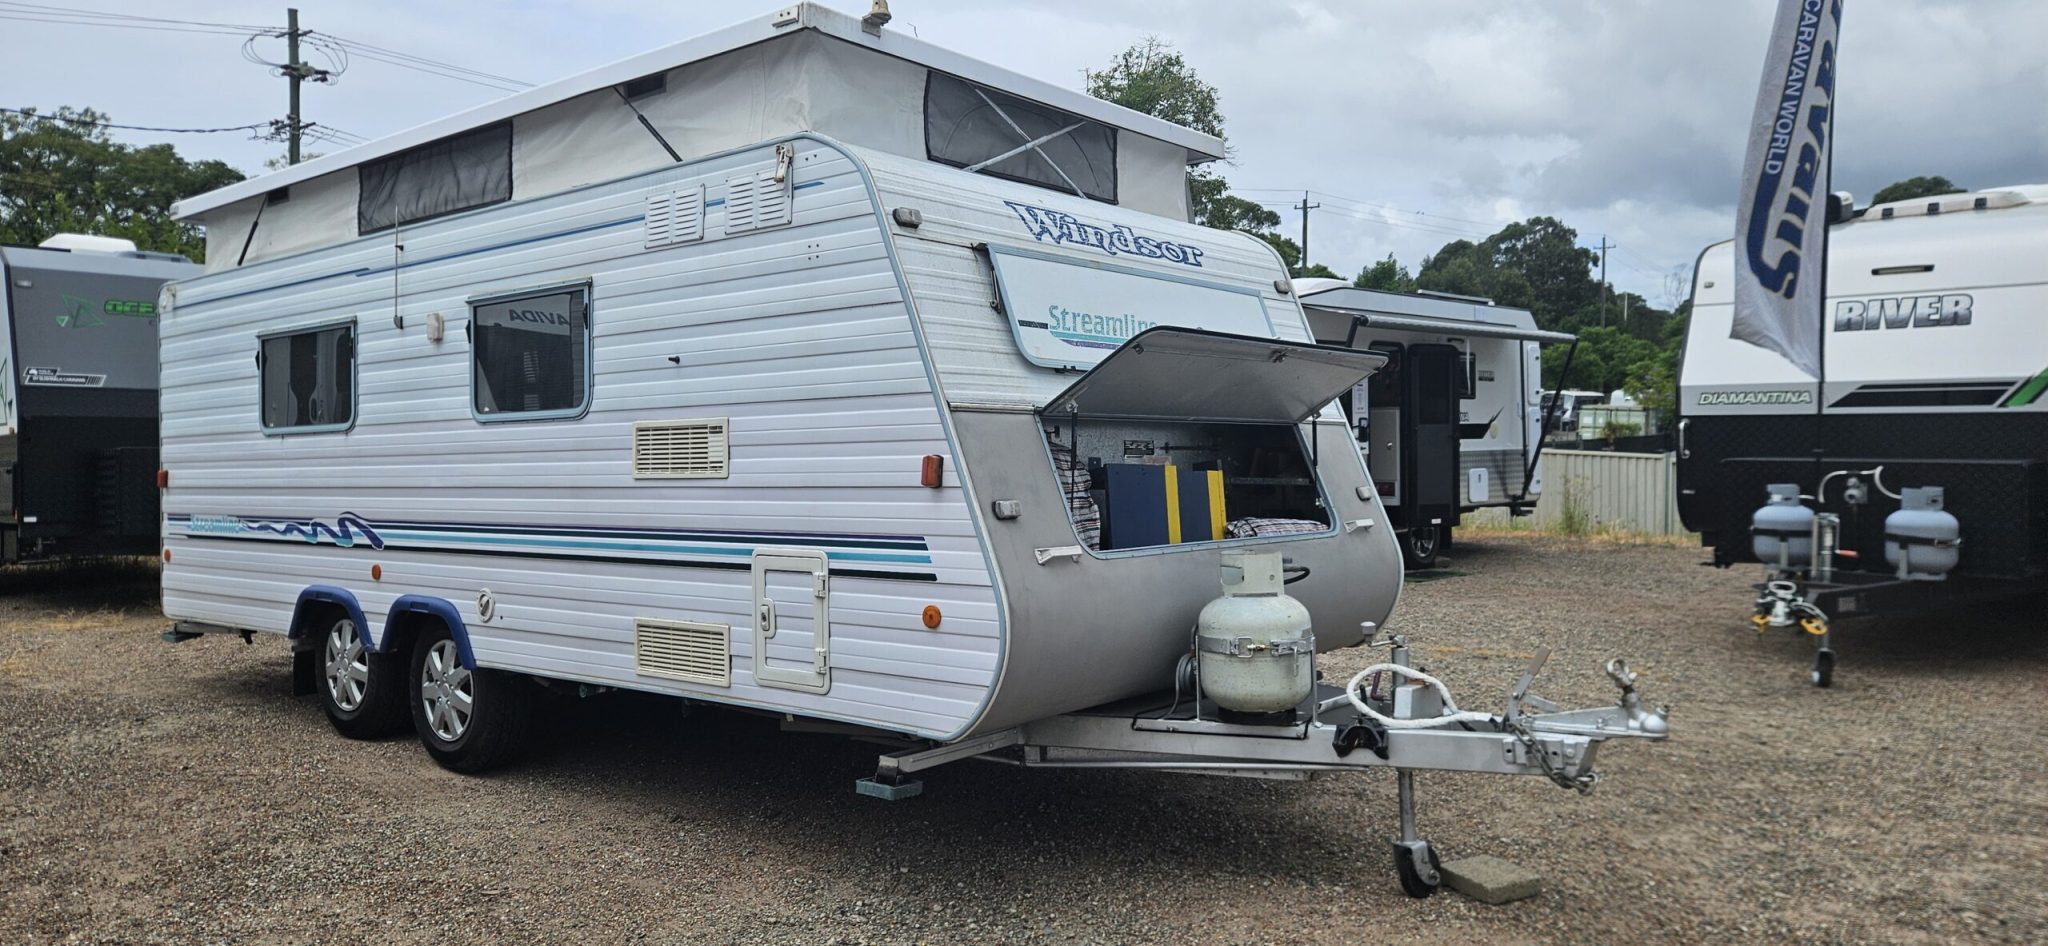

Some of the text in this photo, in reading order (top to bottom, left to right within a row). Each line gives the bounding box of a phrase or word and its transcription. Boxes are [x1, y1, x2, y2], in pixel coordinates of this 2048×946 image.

[1765, 0, 1821, 175] CARAVAN WORLD
[1003, 200, 1204, 267] Windsor
[104, 300, 158, 317] OCE
[1834, 293, 1974, 332] RIVER
[1698, 391, 1813, 405] DIAMANTINA
